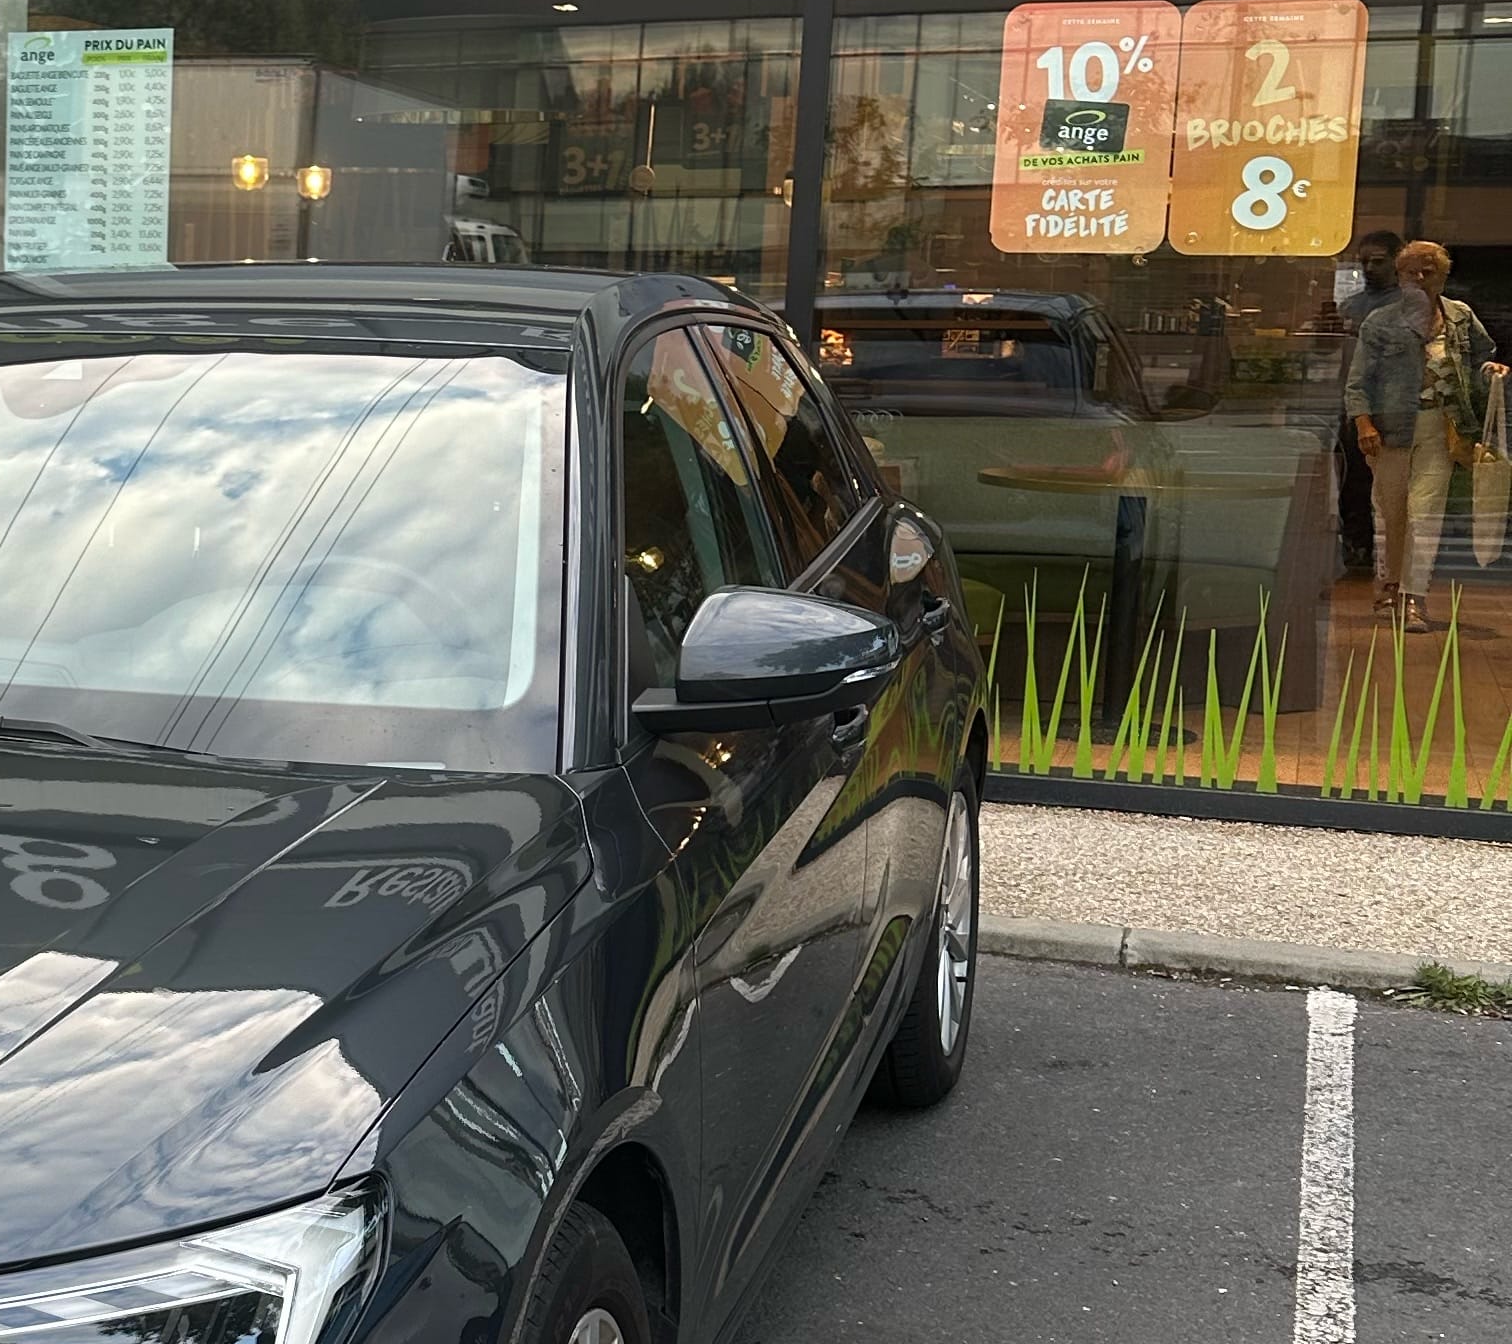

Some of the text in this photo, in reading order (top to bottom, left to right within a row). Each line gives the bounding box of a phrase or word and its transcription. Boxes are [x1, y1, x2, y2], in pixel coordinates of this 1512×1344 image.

[84, 38, 166, 51] PRIX DU PAIN
[20, 50, 55, 64] ange
[1036, 35, 1154, 103] 10%
[1245, 39, 1296, 107] 2
[1058, 125, 1109, 145] ange
[1187, 114, 1348, 151] BRIOCHES
[1024, 153, 1140, 167] DE VOS ACHATS PAIN
[1041, 188, 1115, 212] CARTE
[1025, 209, 1129, 237] FIDÉLITÉ
